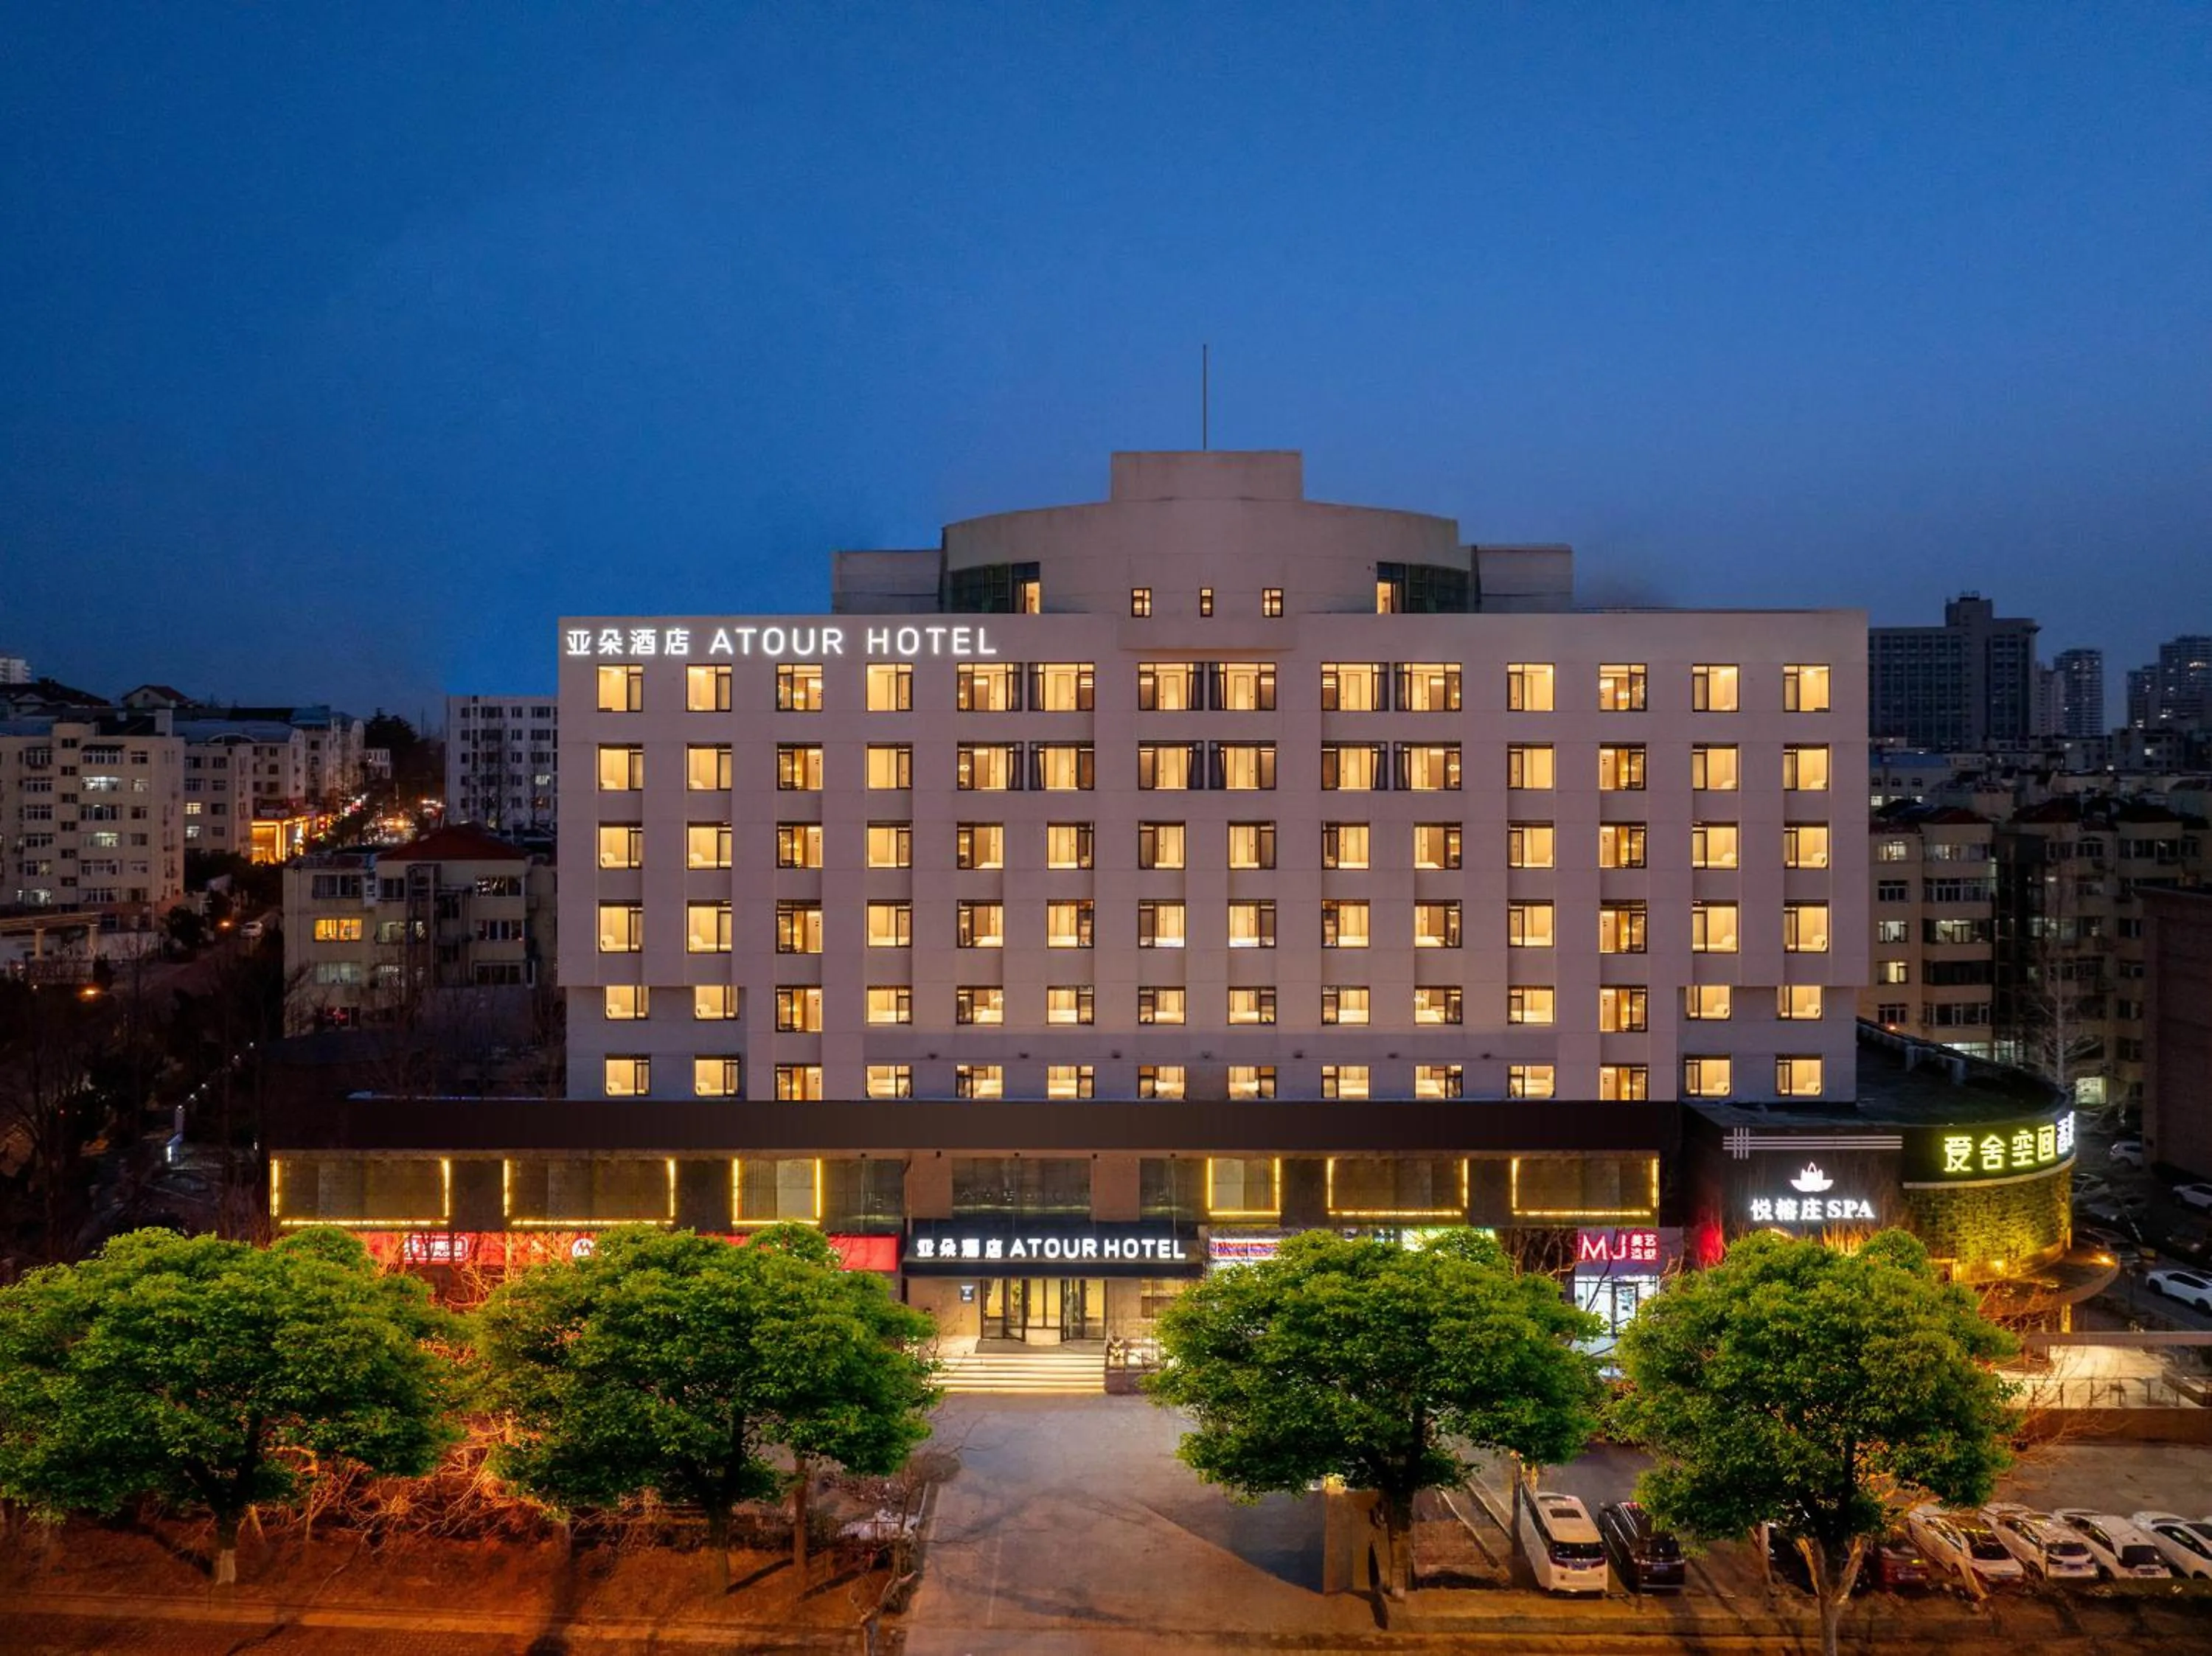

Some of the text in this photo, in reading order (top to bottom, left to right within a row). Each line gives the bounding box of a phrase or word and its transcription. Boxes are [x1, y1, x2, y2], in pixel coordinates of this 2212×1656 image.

[566, 627, 997, 656] 亚朵酒店 ATOUR HOTEL
[1827, 1200, 1875, 1219] SPA
[1010, 1239, 1097, 1259] ATOUR
[1105, 1239, 1186, 1259] HOTEL
[1582, 1235, 1625, 1259] MJ
